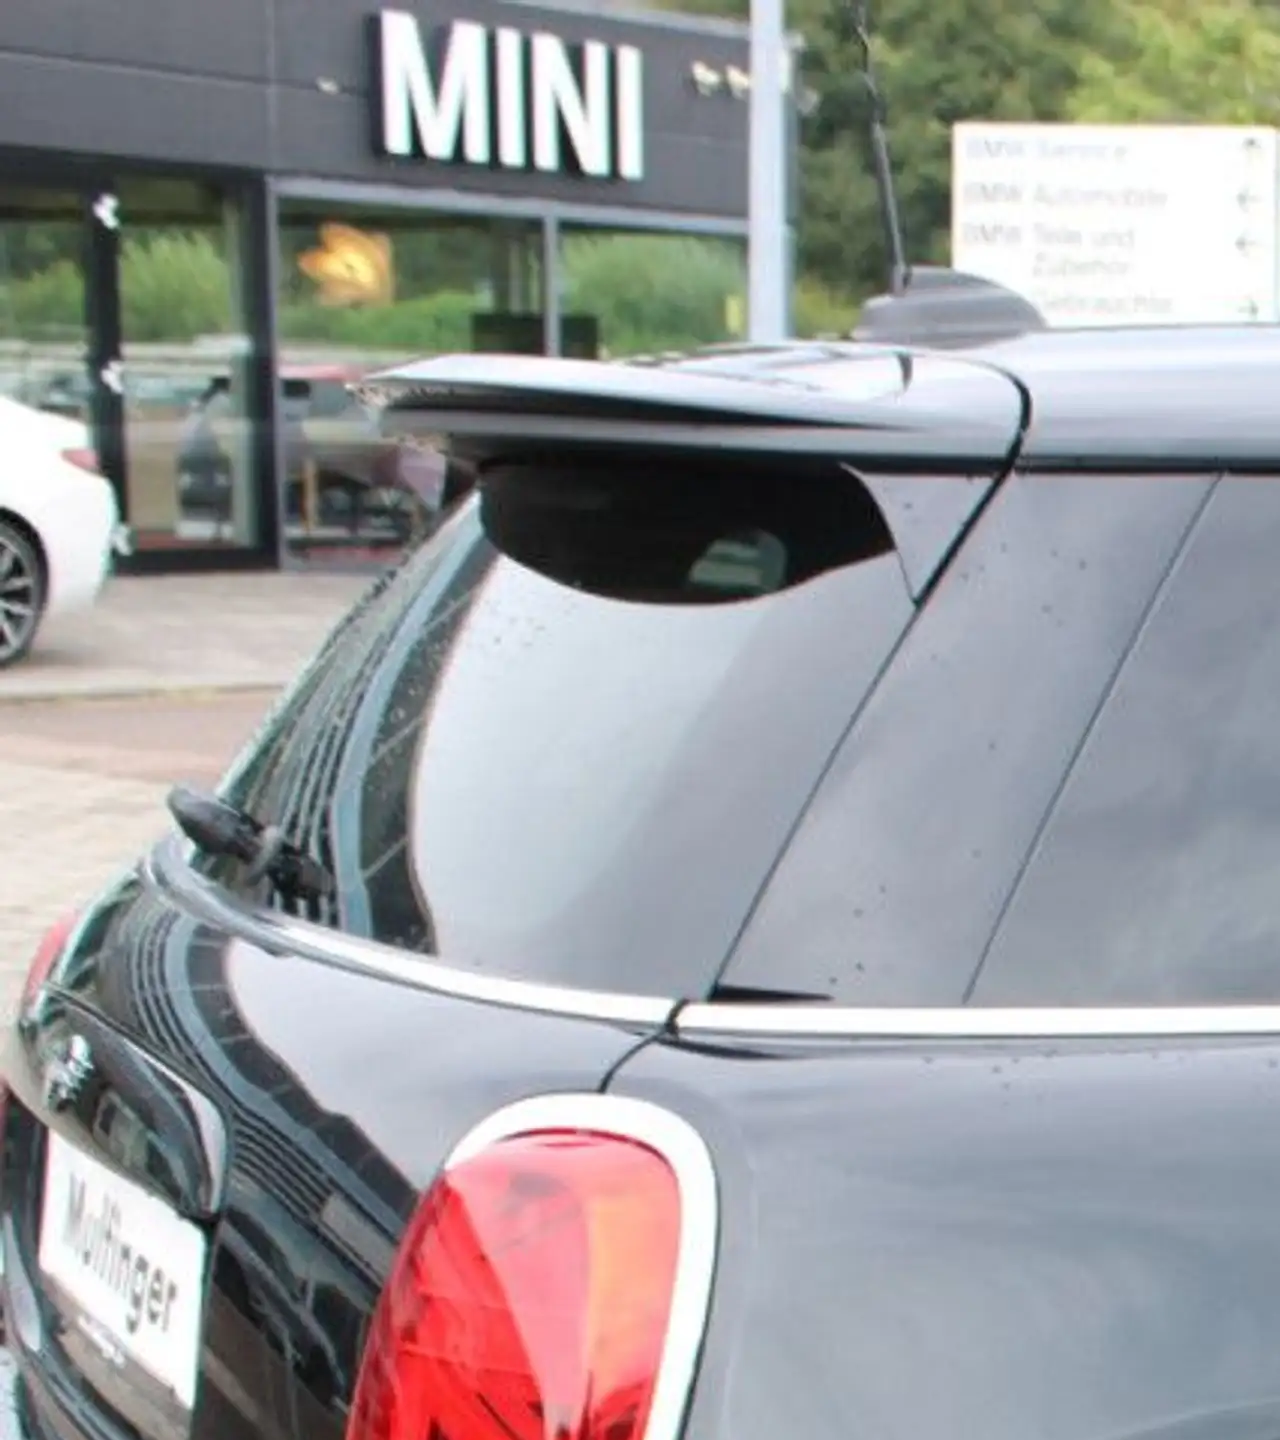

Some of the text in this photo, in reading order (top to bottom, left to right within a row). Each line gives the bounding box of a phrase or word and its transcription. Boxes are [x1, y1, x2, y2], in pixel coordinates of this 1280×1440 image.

[381, 9, 643, 181] MINI
[967, 137, 1023, 159] BMW
[963, 181, 1022, 203] BMW
[962, 223, 1021, 244] BMW
[1092, 228, 1135, 246] und
[64, 1170, 178, 1335] Mulfinger
